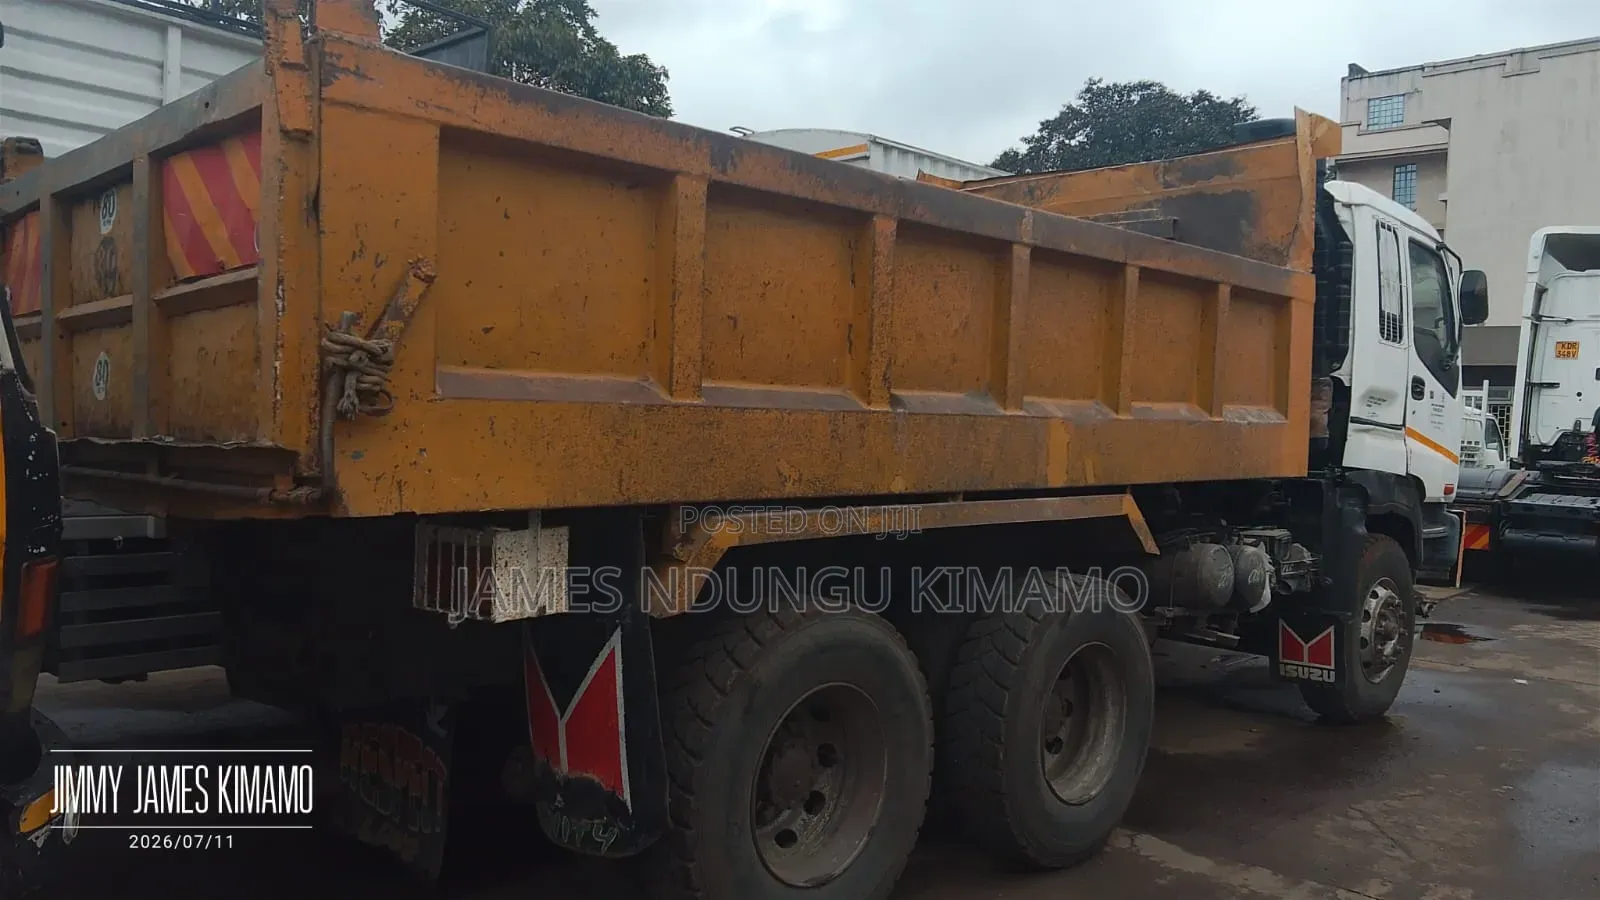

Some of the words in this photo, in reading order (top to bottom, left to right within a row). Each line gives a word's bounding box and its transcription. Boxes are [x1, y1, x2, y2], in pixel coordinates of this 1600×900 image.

[102, 190, 116, 220] 80
[1561, 342, 1577, 350] KDR
[1279, 663, 1336, 683] ISUZU
